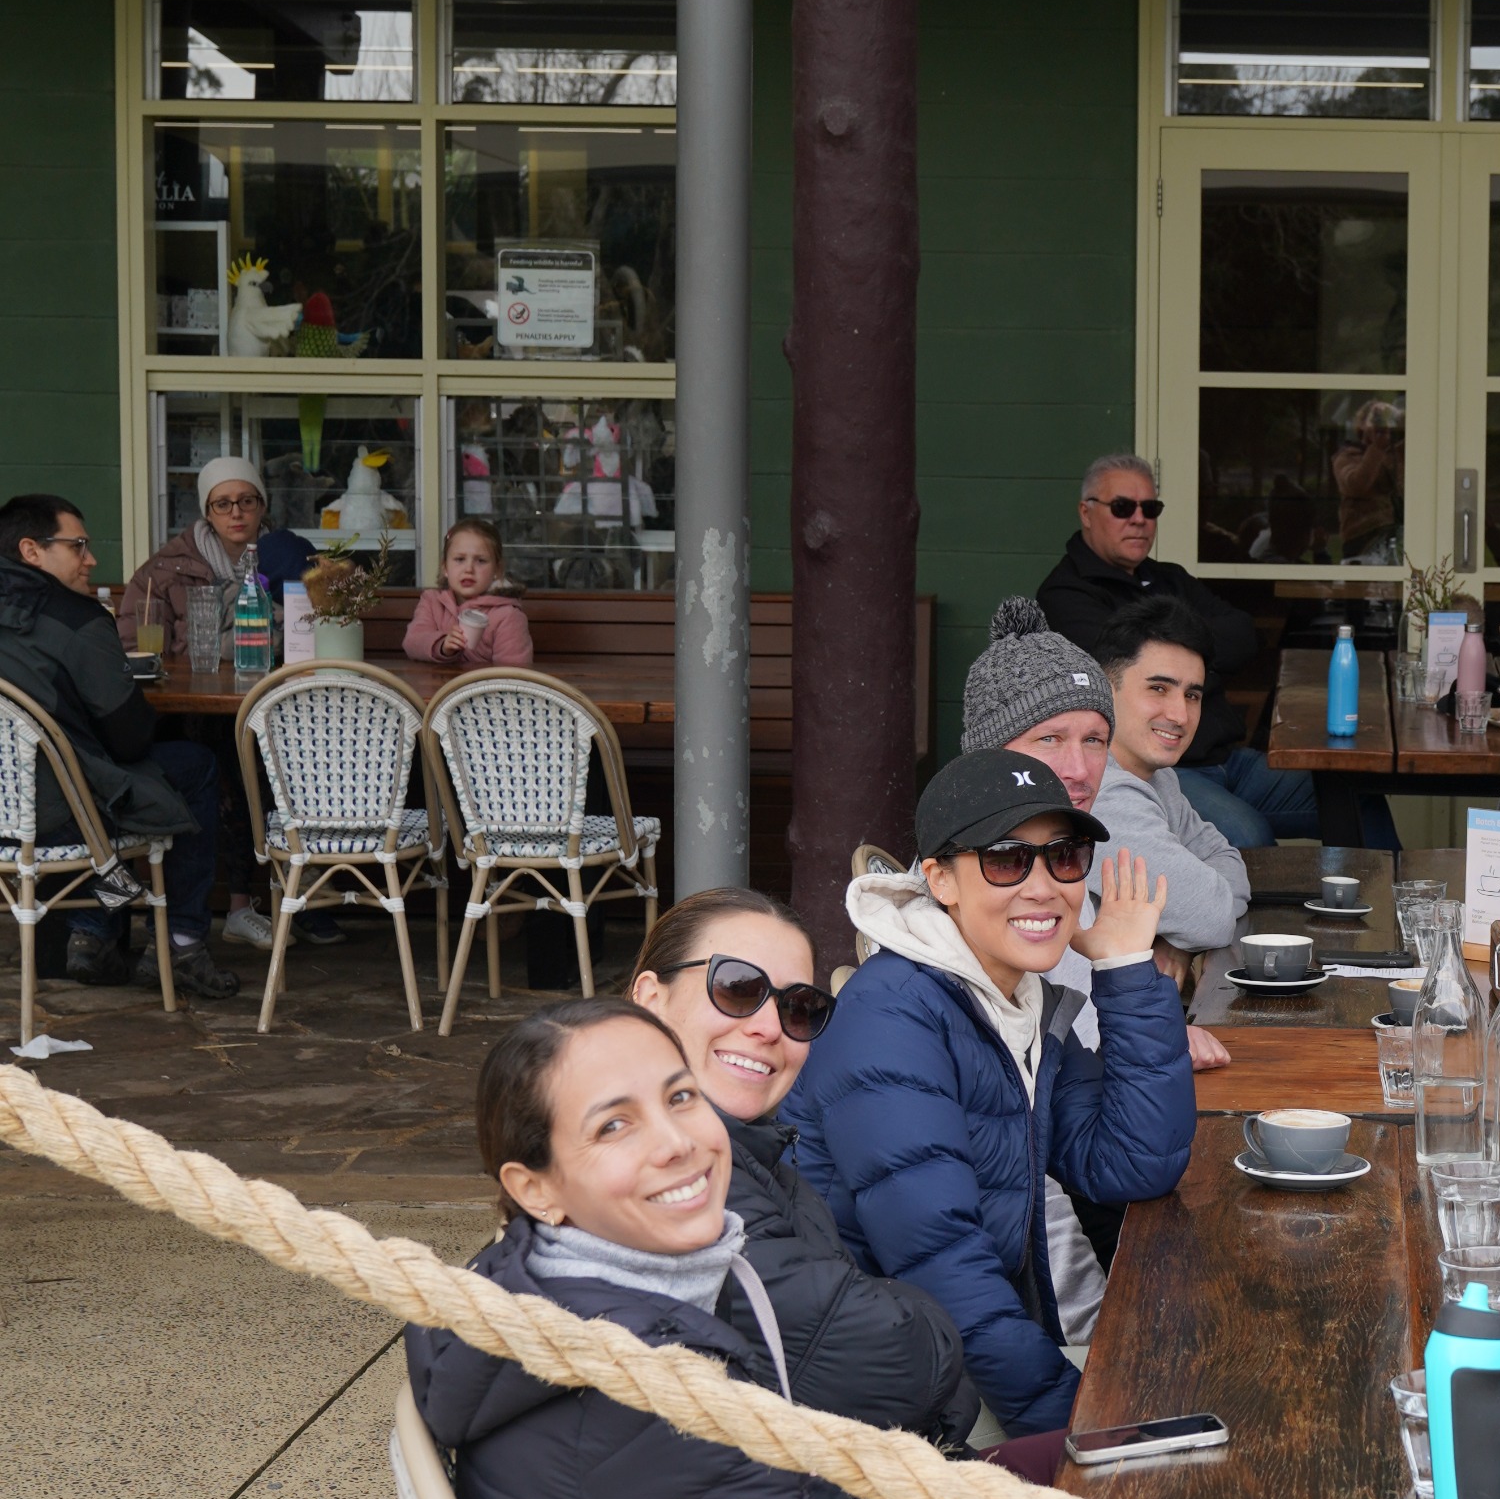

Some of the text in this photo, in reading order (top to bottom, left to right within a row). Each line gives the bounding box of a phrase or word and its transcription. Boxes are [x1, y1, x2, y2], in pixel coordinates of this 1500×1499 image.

[516, 332, 576, 341] PENALTIES APPLY
[1475, 817, 1496, 826] Batch
